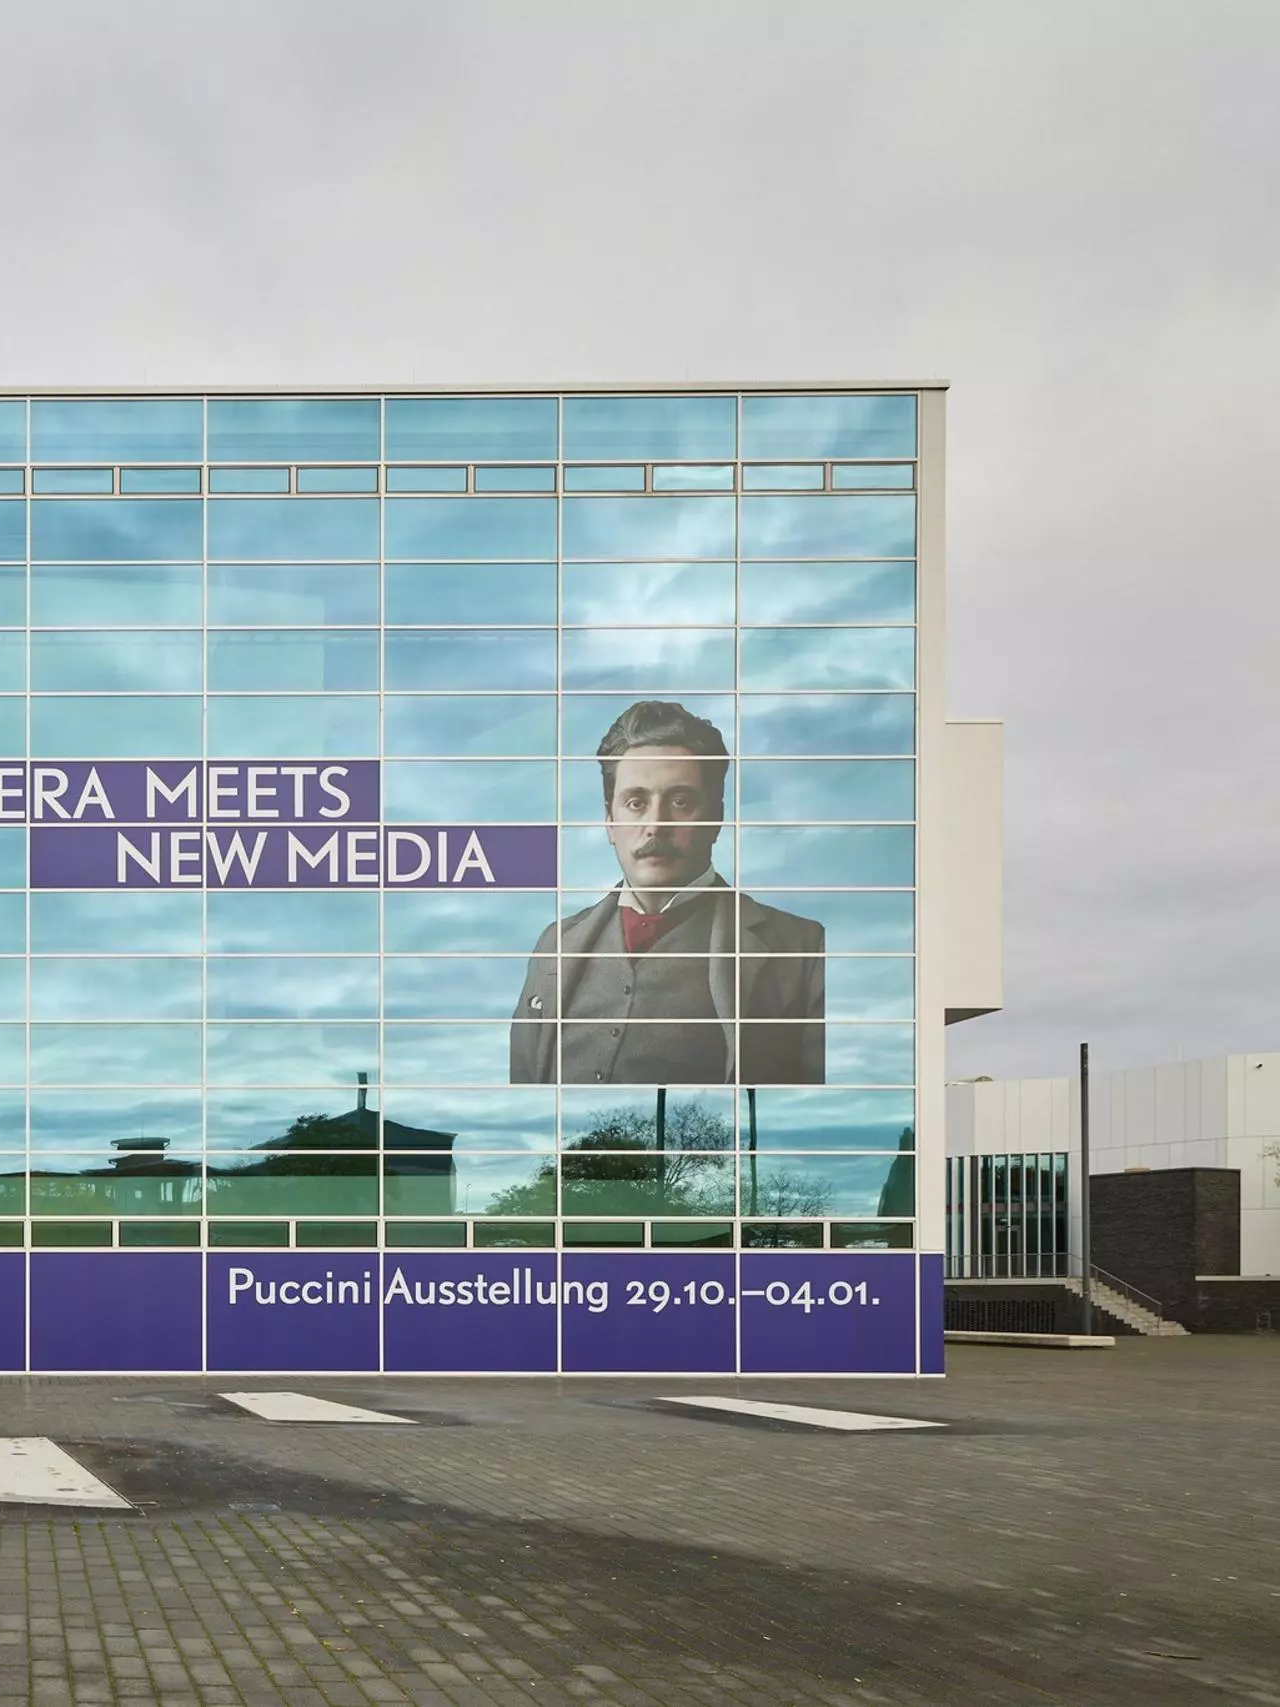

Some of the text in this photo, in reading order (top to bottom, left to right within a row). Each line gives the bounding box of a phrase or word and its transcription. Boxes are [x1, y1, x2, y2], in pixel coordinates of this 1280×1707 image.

[145, 765, 351, 819] MEETS
[116, 829, 496, 886] NEW MEDIA
[228, 1267, 372, 1305] Puccini
[384, 1267, 609, 1313] Ausstellung
